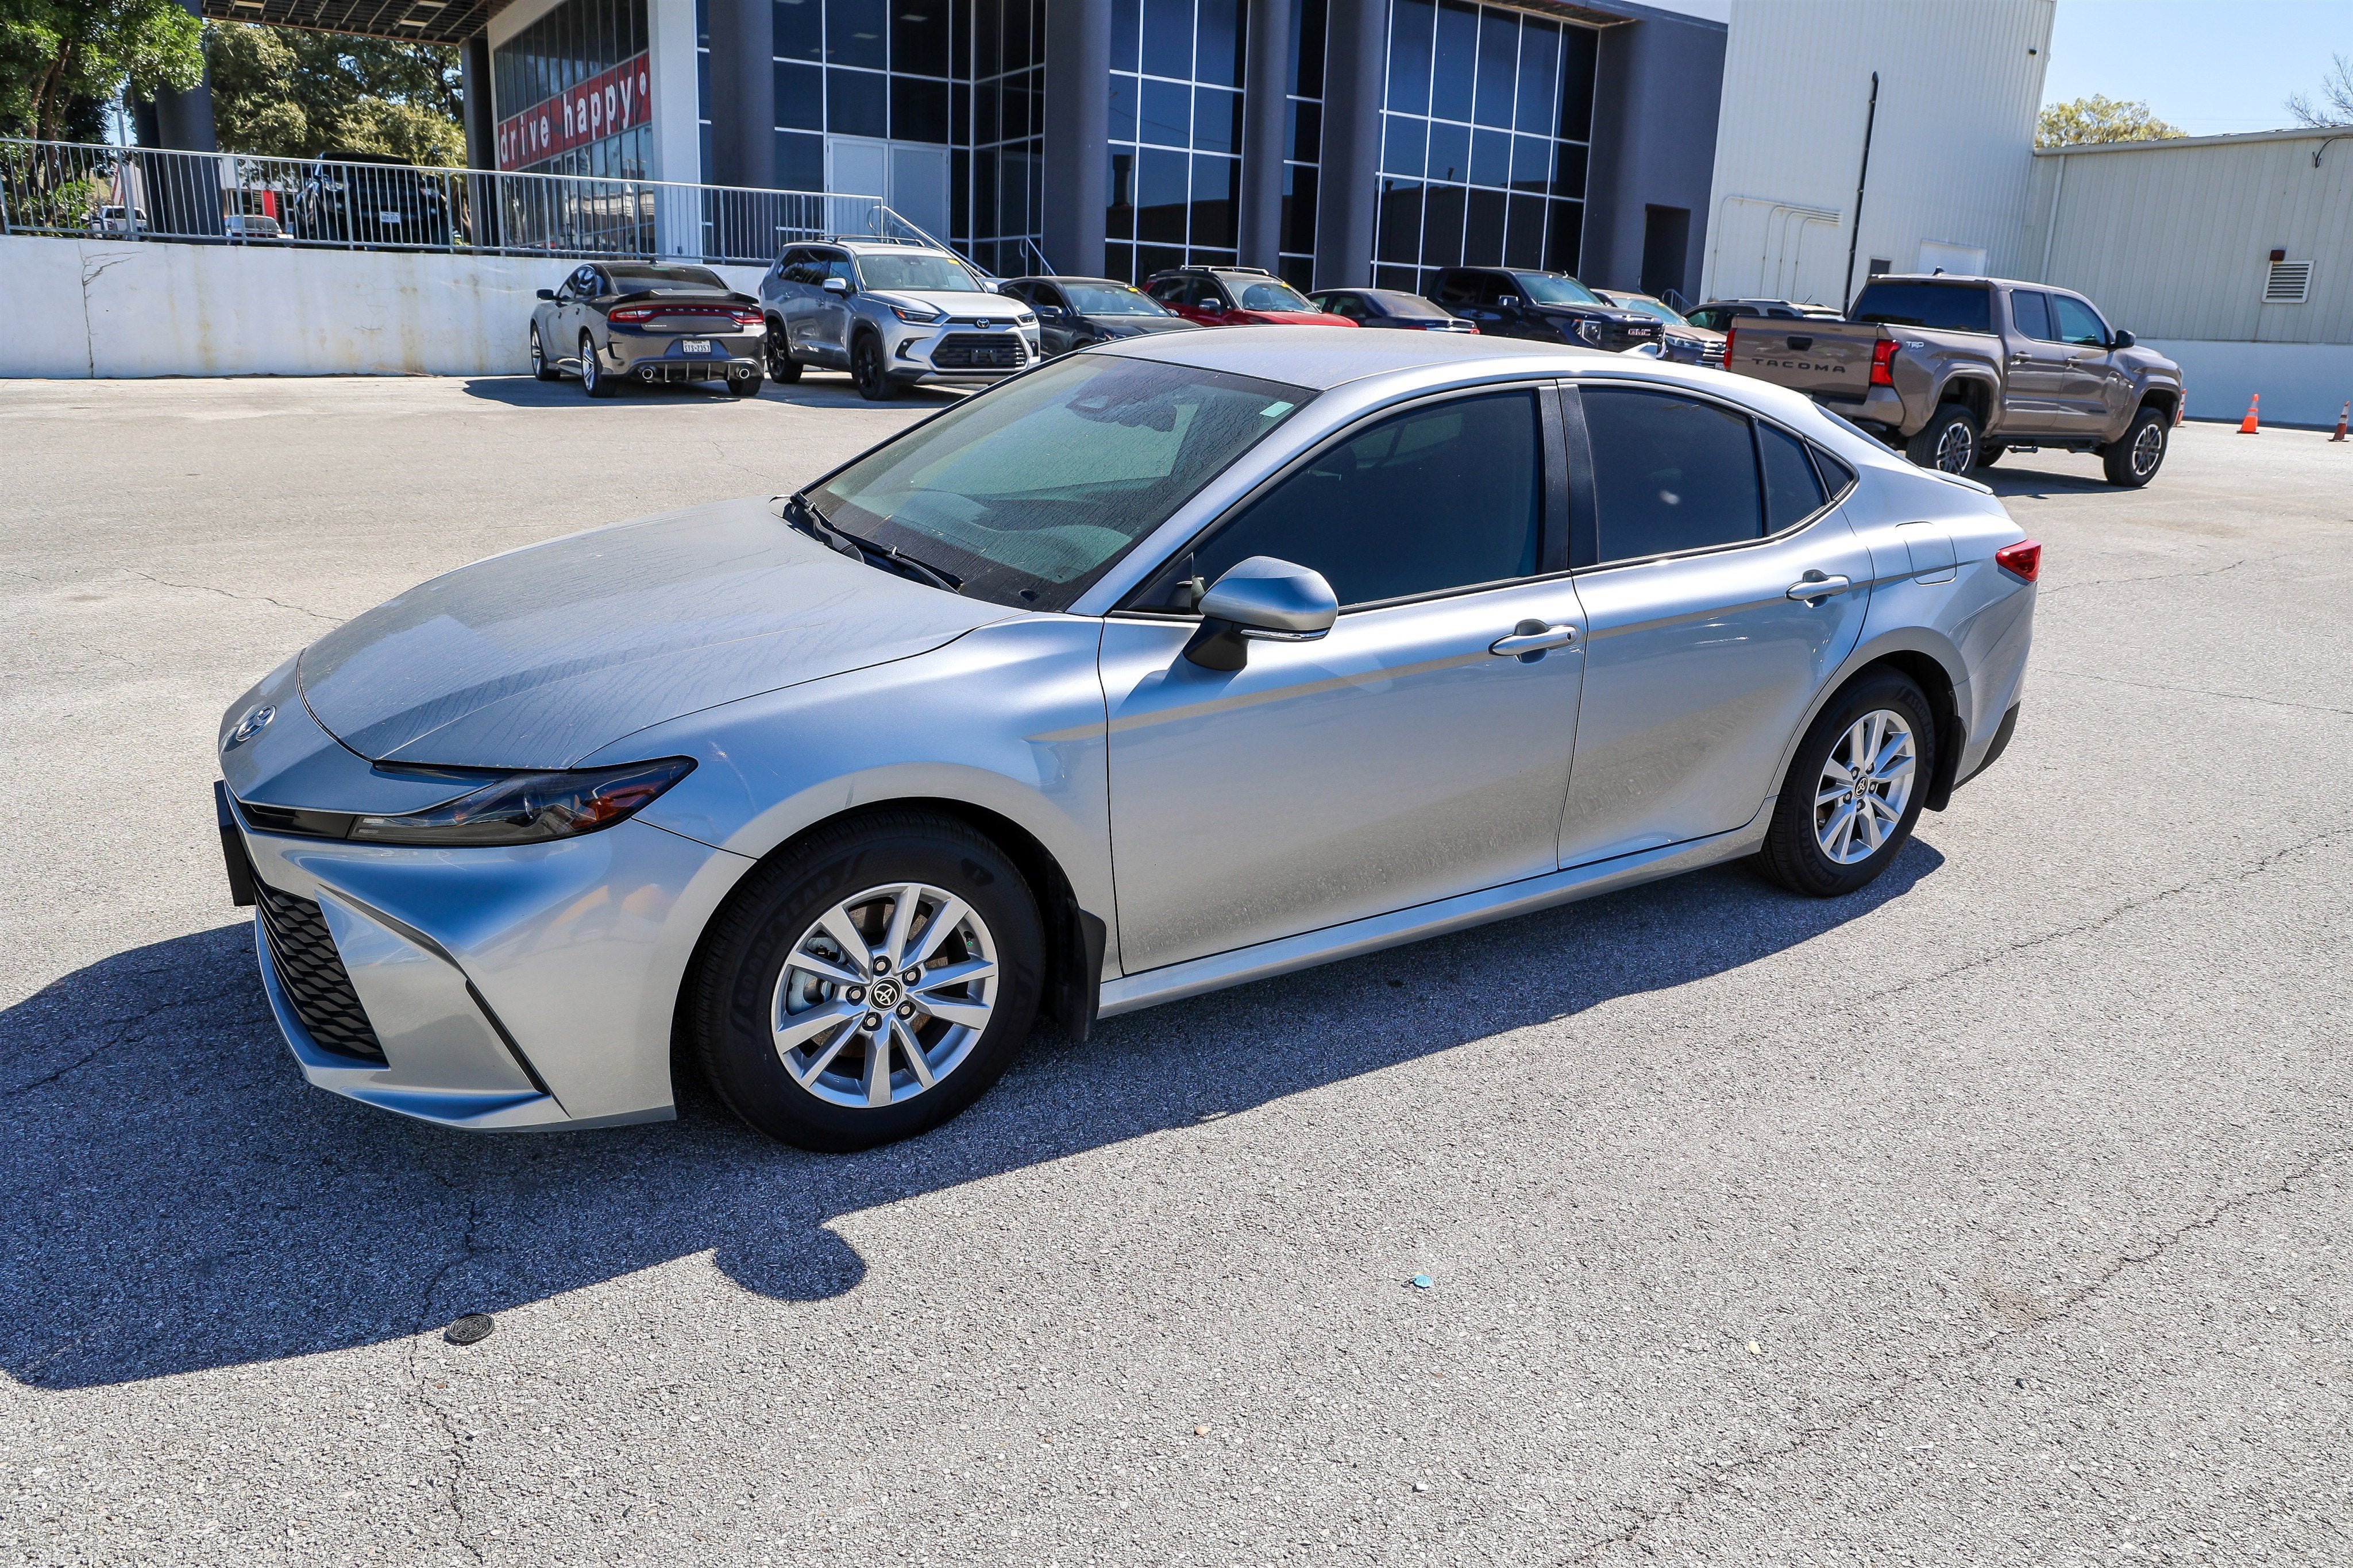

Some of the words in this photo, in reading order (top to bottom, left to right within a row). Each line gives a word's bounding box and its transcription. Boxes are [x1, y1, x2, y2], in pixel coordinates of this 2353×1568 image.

[500, 115, 549, 164] drive
[1628, 328, 1651, 336] GMC
[1752, 358, 1846, 373] TACOMA
[738, 874, 833, 1007] GOODYEAR
